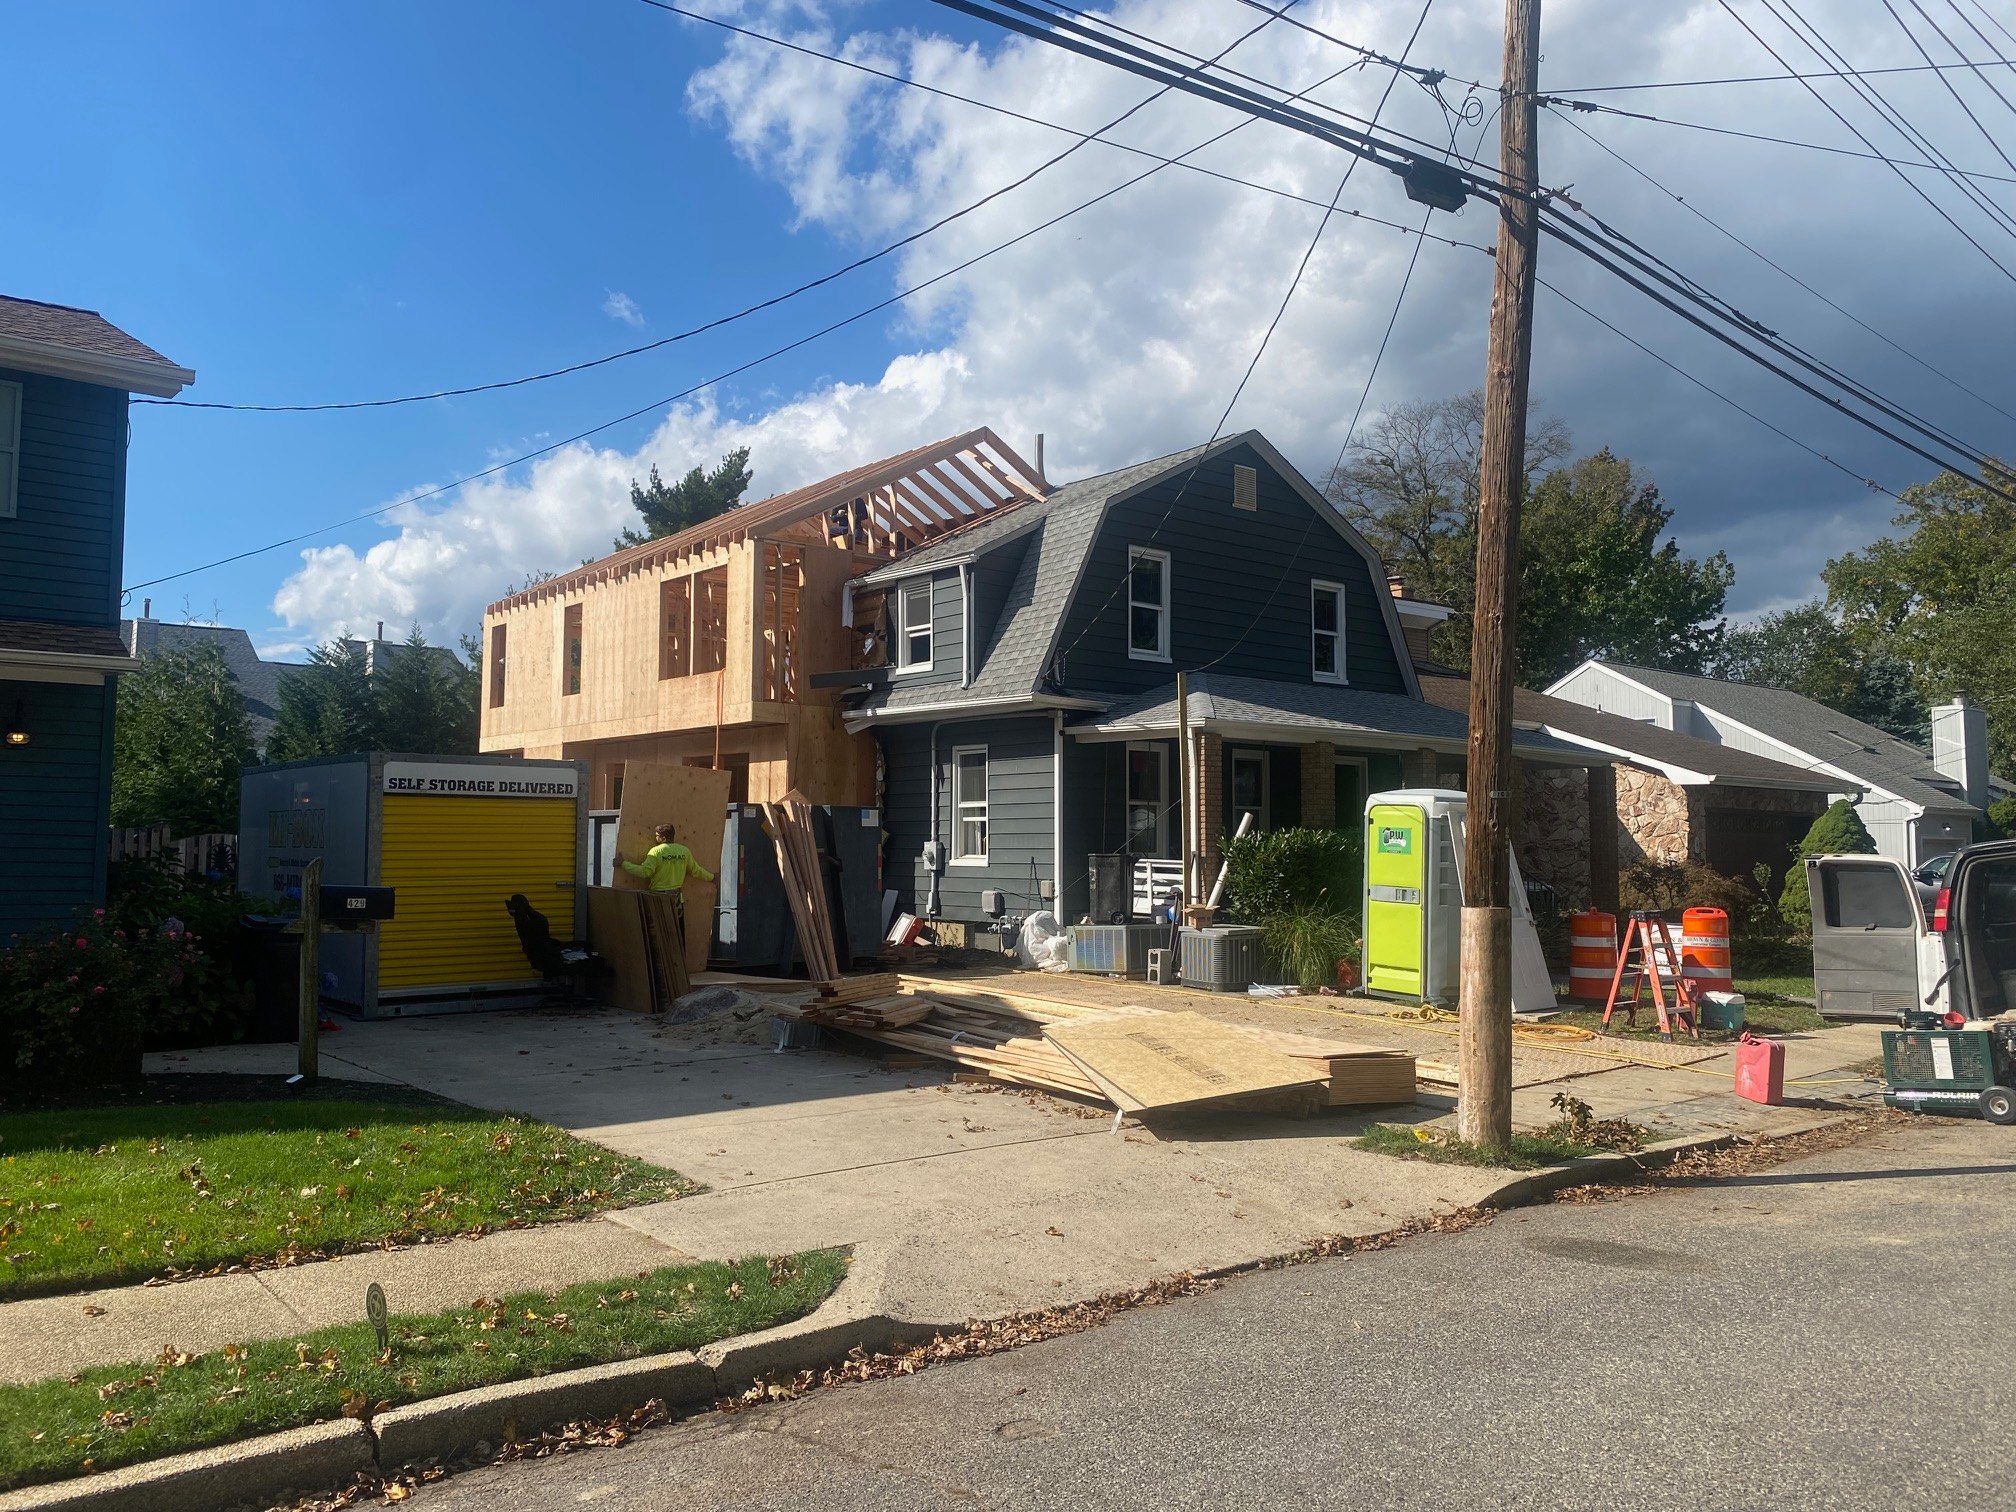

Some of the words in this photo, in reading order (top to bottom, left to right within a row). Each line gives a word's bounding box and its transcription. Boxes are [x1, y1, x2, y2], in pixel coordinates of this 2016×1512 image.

[388, 777, 425, 790] SELF
[429, 779, 495, 793] STORAGE
[498, 781, 574, 795] DELIVERED
[348, 899, 365, 908] 429
